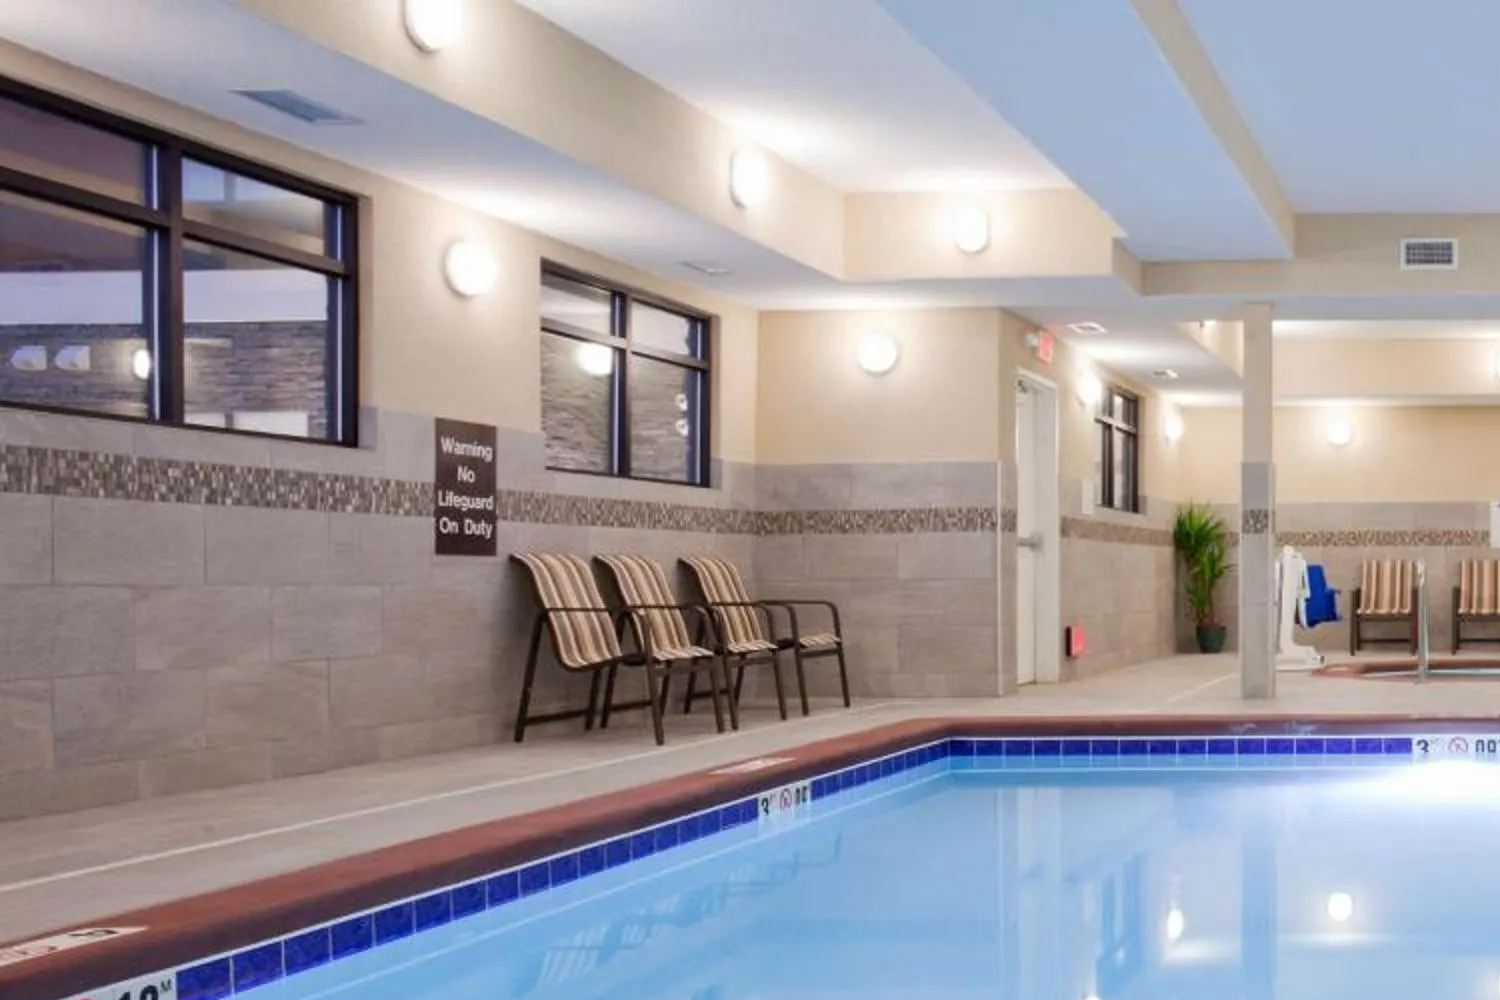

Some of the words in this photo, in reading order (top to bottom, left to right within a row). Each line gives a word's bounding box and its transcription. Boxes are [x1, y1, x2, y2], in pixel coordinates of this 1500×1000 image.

[440, 436, 493, 462] Warning
[457, 466, 475, 483] No
[437, 489, 494, 511] Lifeguard
[439, 517, 458, 534] On
[464, 518, 493, 539] Duty
